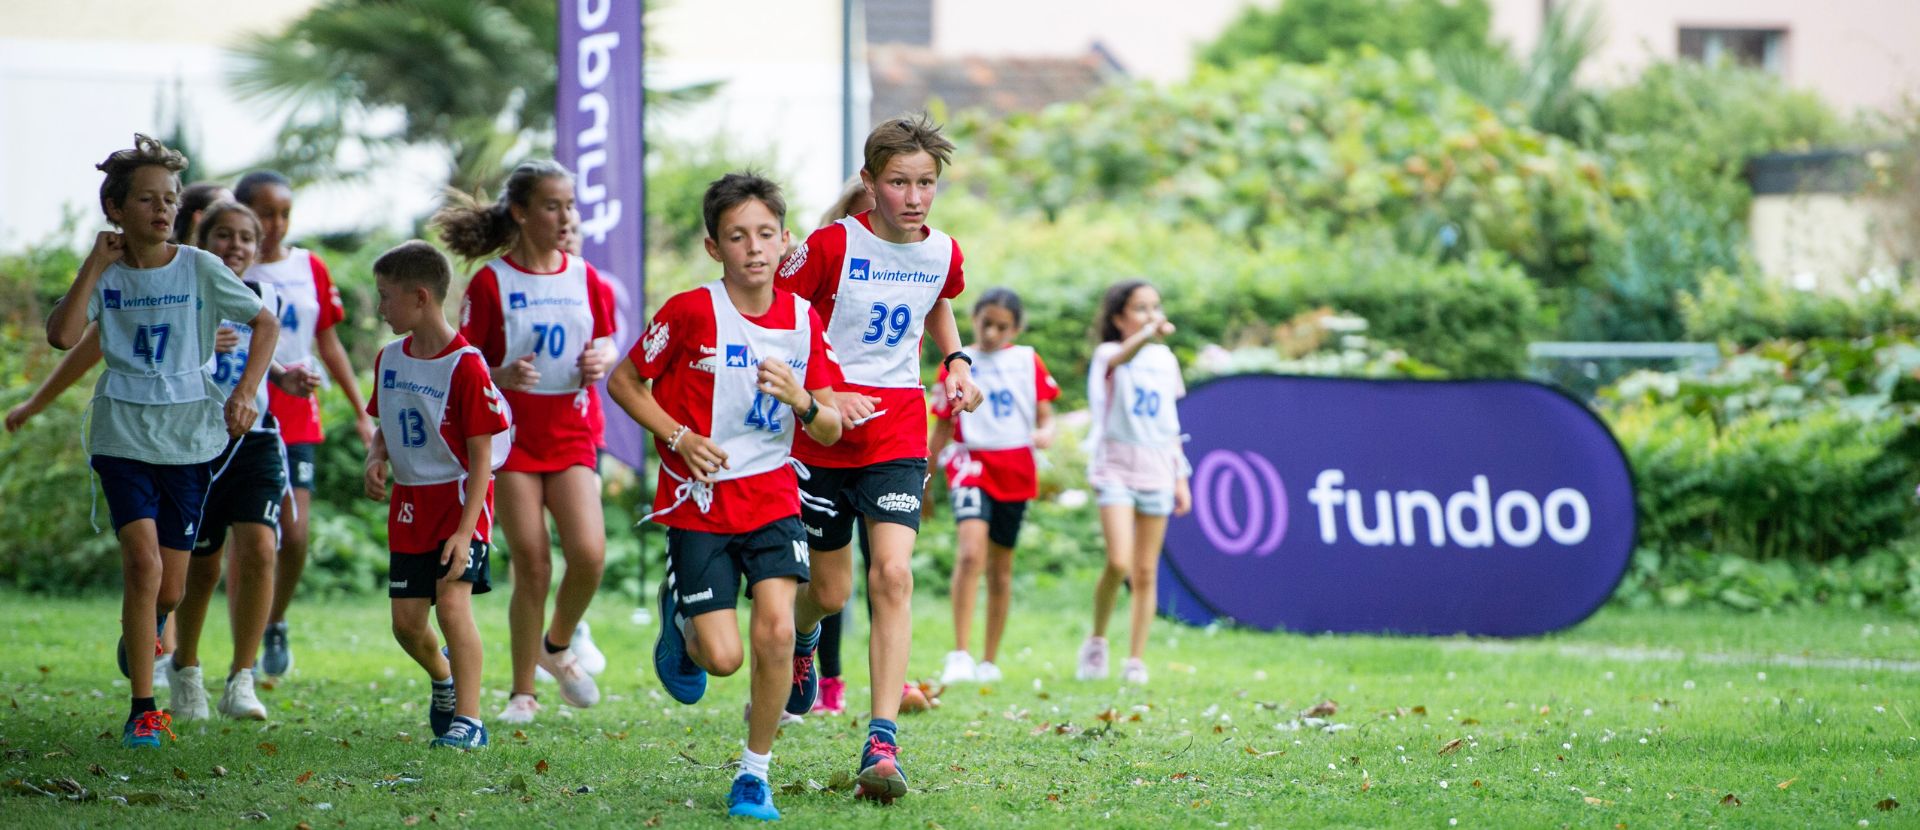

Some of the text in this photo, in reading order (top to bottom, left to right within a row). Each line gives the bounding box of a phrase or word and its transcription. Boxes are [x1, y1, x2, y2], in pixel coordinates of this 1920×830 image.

[872, 269, 940, 284] winterthur
[123, 293, 190, 308] winterthur
[532, 323, 566, 358] 70
[862, 302, 912, 347] 39
[133, 323, 171, 364] 47
[744, 390, 784, 433] 42
[989, 388, 1014, 418] 19
[1132, 386, 1160, 417] 20
[398, 408, 427, 448] 13
[1307, 469, 1592, 548] fundoo
